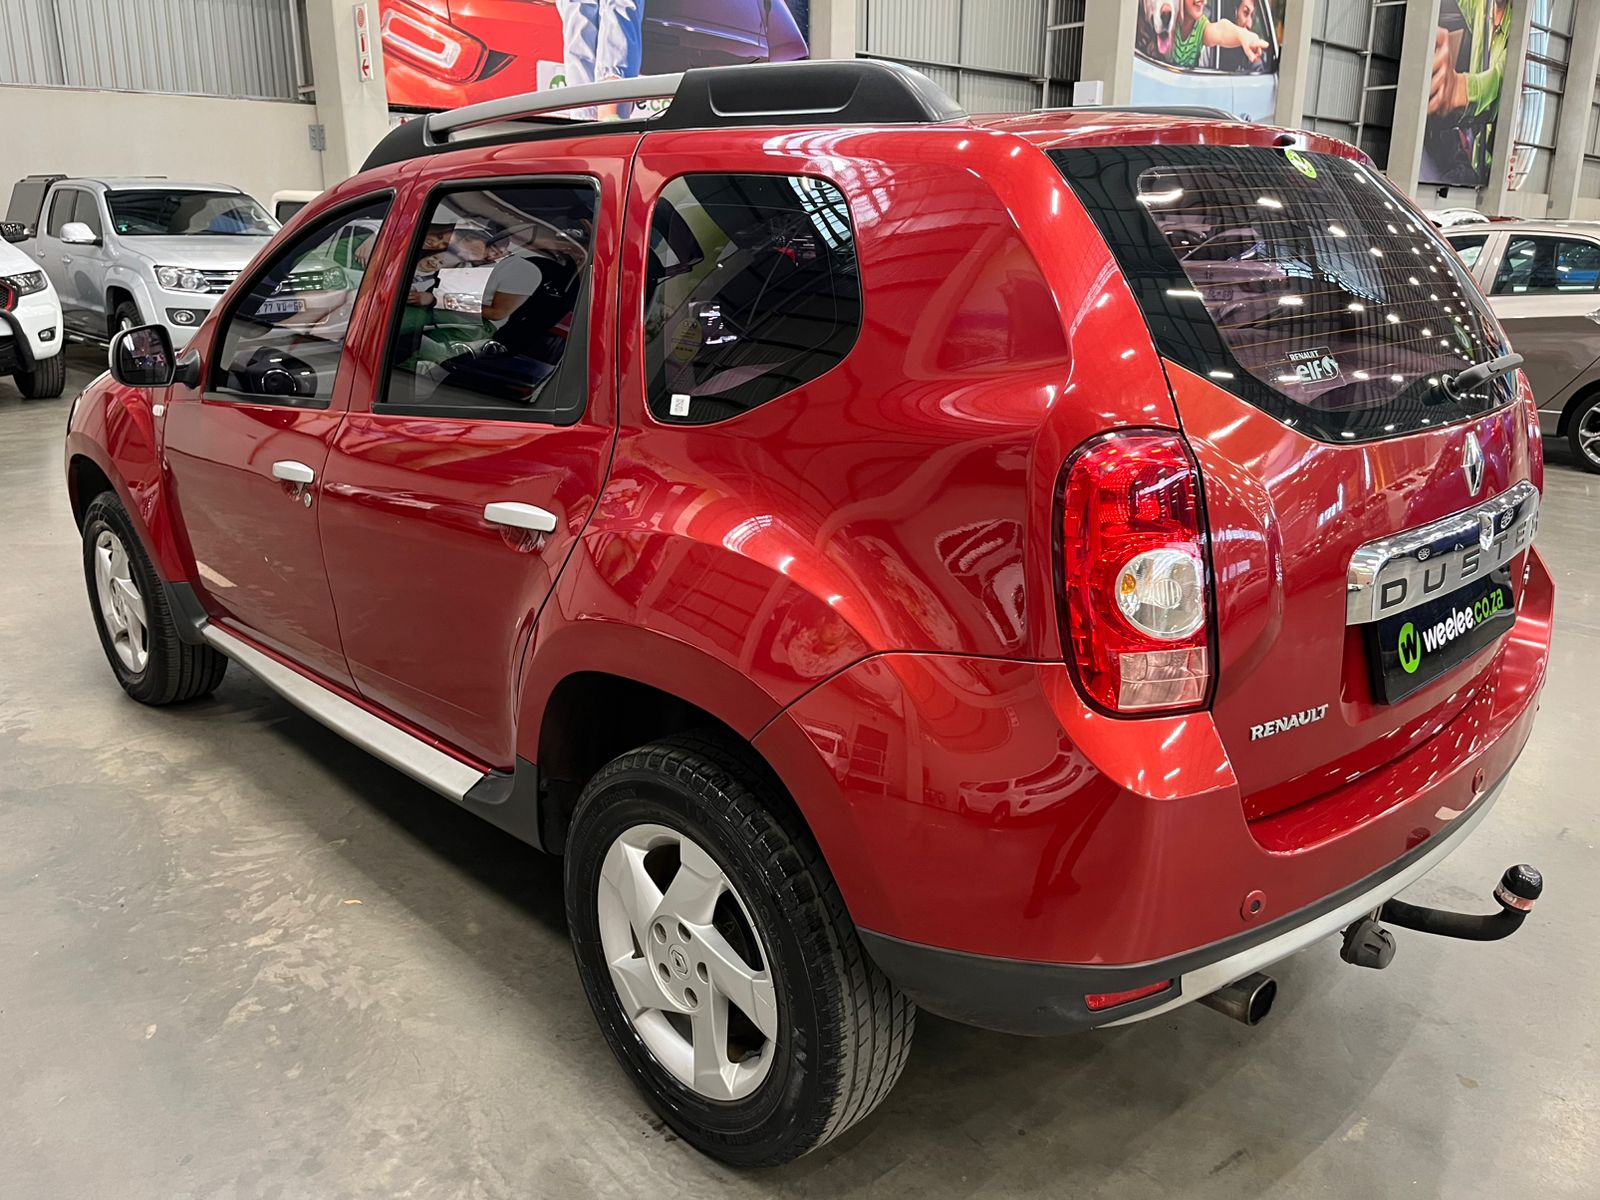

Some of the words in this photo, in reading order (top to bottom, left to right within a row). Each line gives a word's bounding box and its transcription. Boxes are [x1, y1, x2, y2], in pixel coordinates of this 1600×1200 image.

[1289, 350, 1319, 361] RENAULT
[1296, 360, 1322, 381] elf
[1422, 588, 1504, 653] weelee.co.za
[1250, 703, 1329, 741] RENAULT
